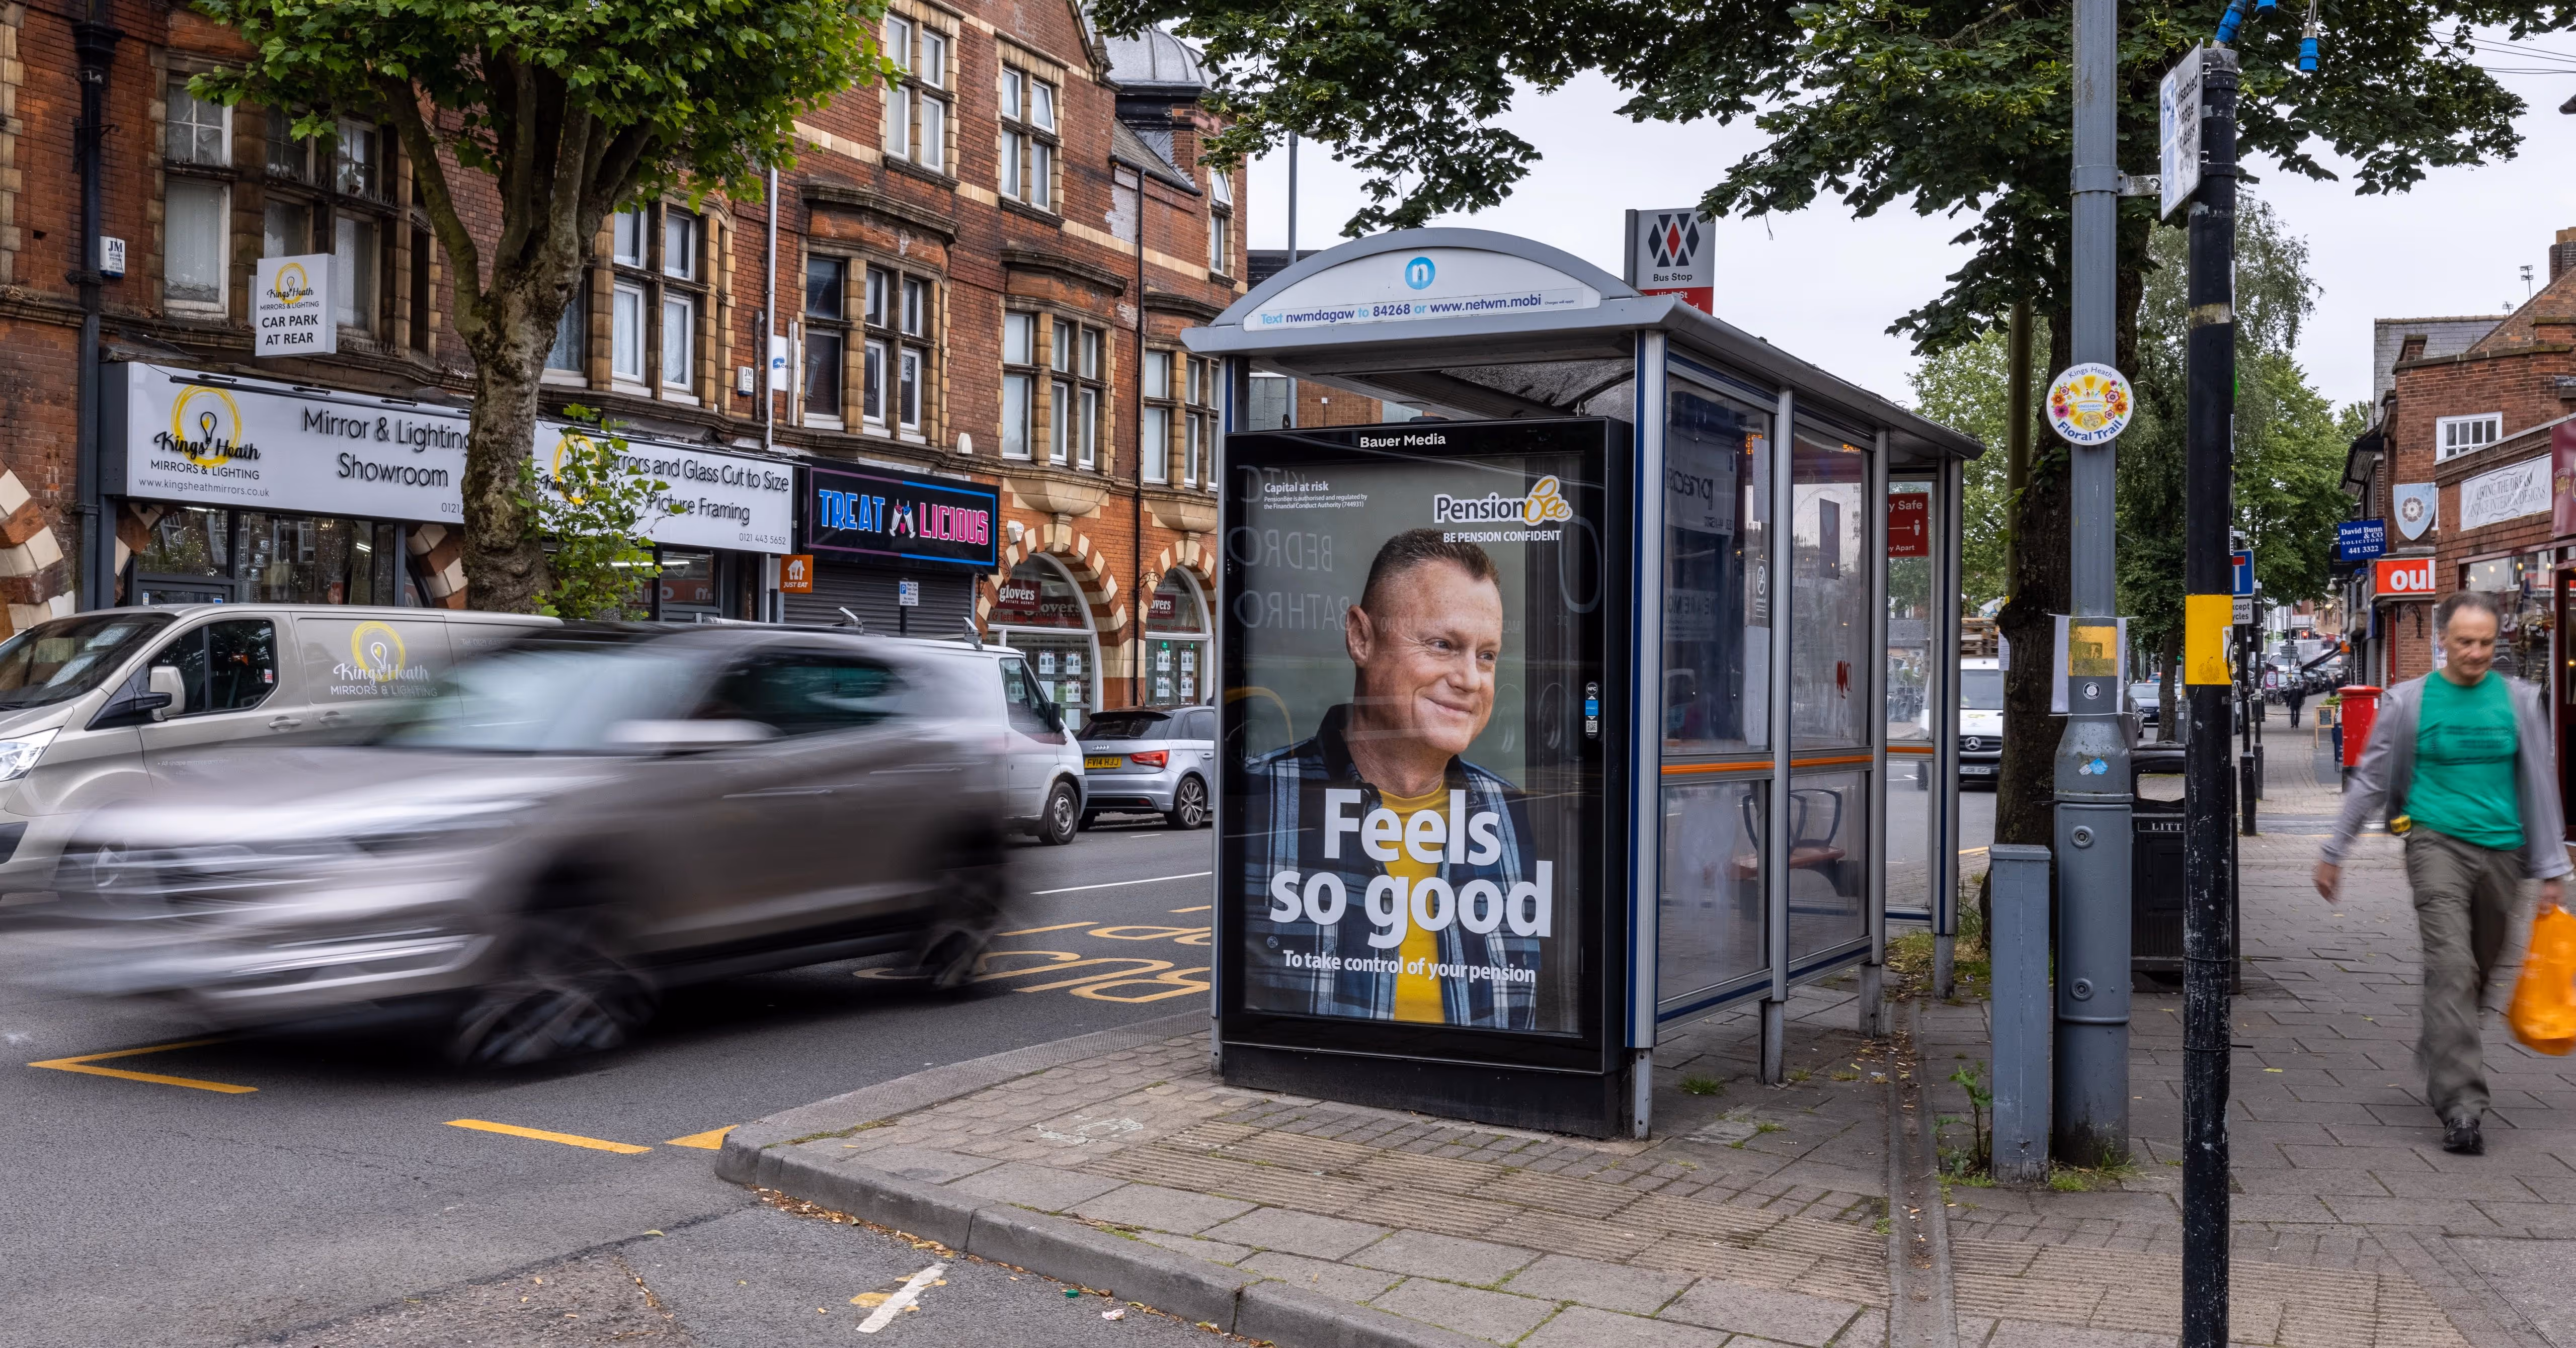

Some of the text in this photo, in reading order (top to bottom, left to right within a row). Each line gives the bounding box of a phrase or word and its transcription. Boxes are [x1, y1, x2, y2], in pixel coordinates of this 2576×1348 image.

[2178, 102, 2194, 124] adge
[108, 240, 123, 252] JM
[1653, 273, 1693, 282] Bus Stop
[267, 287, 314, 300] Kings Heath
[1261, 294, 1541, 324] Text nwmdagaw to 84268 or www.netwm.mobi
[262, 314, 318, 328] CAR PARK
[266, 332, 313, 346] AT REAR
[745, 369, 752, 377] JM
[2068, 367, 2112, 378] Kings Heath
[303, 405, 370, 439] Mirror
[377, 417, 390, 442] &
[2058, 420, 2123, 441] Floral Trail
[153, 431, 261, 460] Kings Heath
[1360, 433, 1446, 448] Bauer Media
[151, 459, 260, 479] MIRRORS & LIGHTING
[338, 452, 449, 487] Showroom
[601, 449, 789, 492] irrors and Glass Cut to Size
[139, 478, 270, 496] www.kingsheathmirrors.co.uk
[1264, 481, 1329, 494] Capital at risk
[2498, 480, 2509, 494] THE
[441, 502, 460, 513] 0121
[700, 497, 750, 526] Framing
[1898, 500, 1922, 510] Safe
[819, 489, 989, 546] TREAT LICIOUS
[739, 533, 786, 545] 0121 443 5652
[1443, 530, 1561, 543] BE PENSION CONFIDENT
[999, 584, 1034, 602] glovers
[1151, 600, 1171, 610] overs
[2233, 603, 2250, 611] xcept
[2233, 612, 2249, 621] ycles
[334, 663, 429, 685] Kings Heath
[331, 686, 438, 697] MIRRORS & LIGHTING
[1087, 759, 1102, 767] FV14
[1324, 788, 1501, 866] Feels
[1269, 860, 1553, 949] so good
[1283, 950, 1536, 983] To take control of your pension
